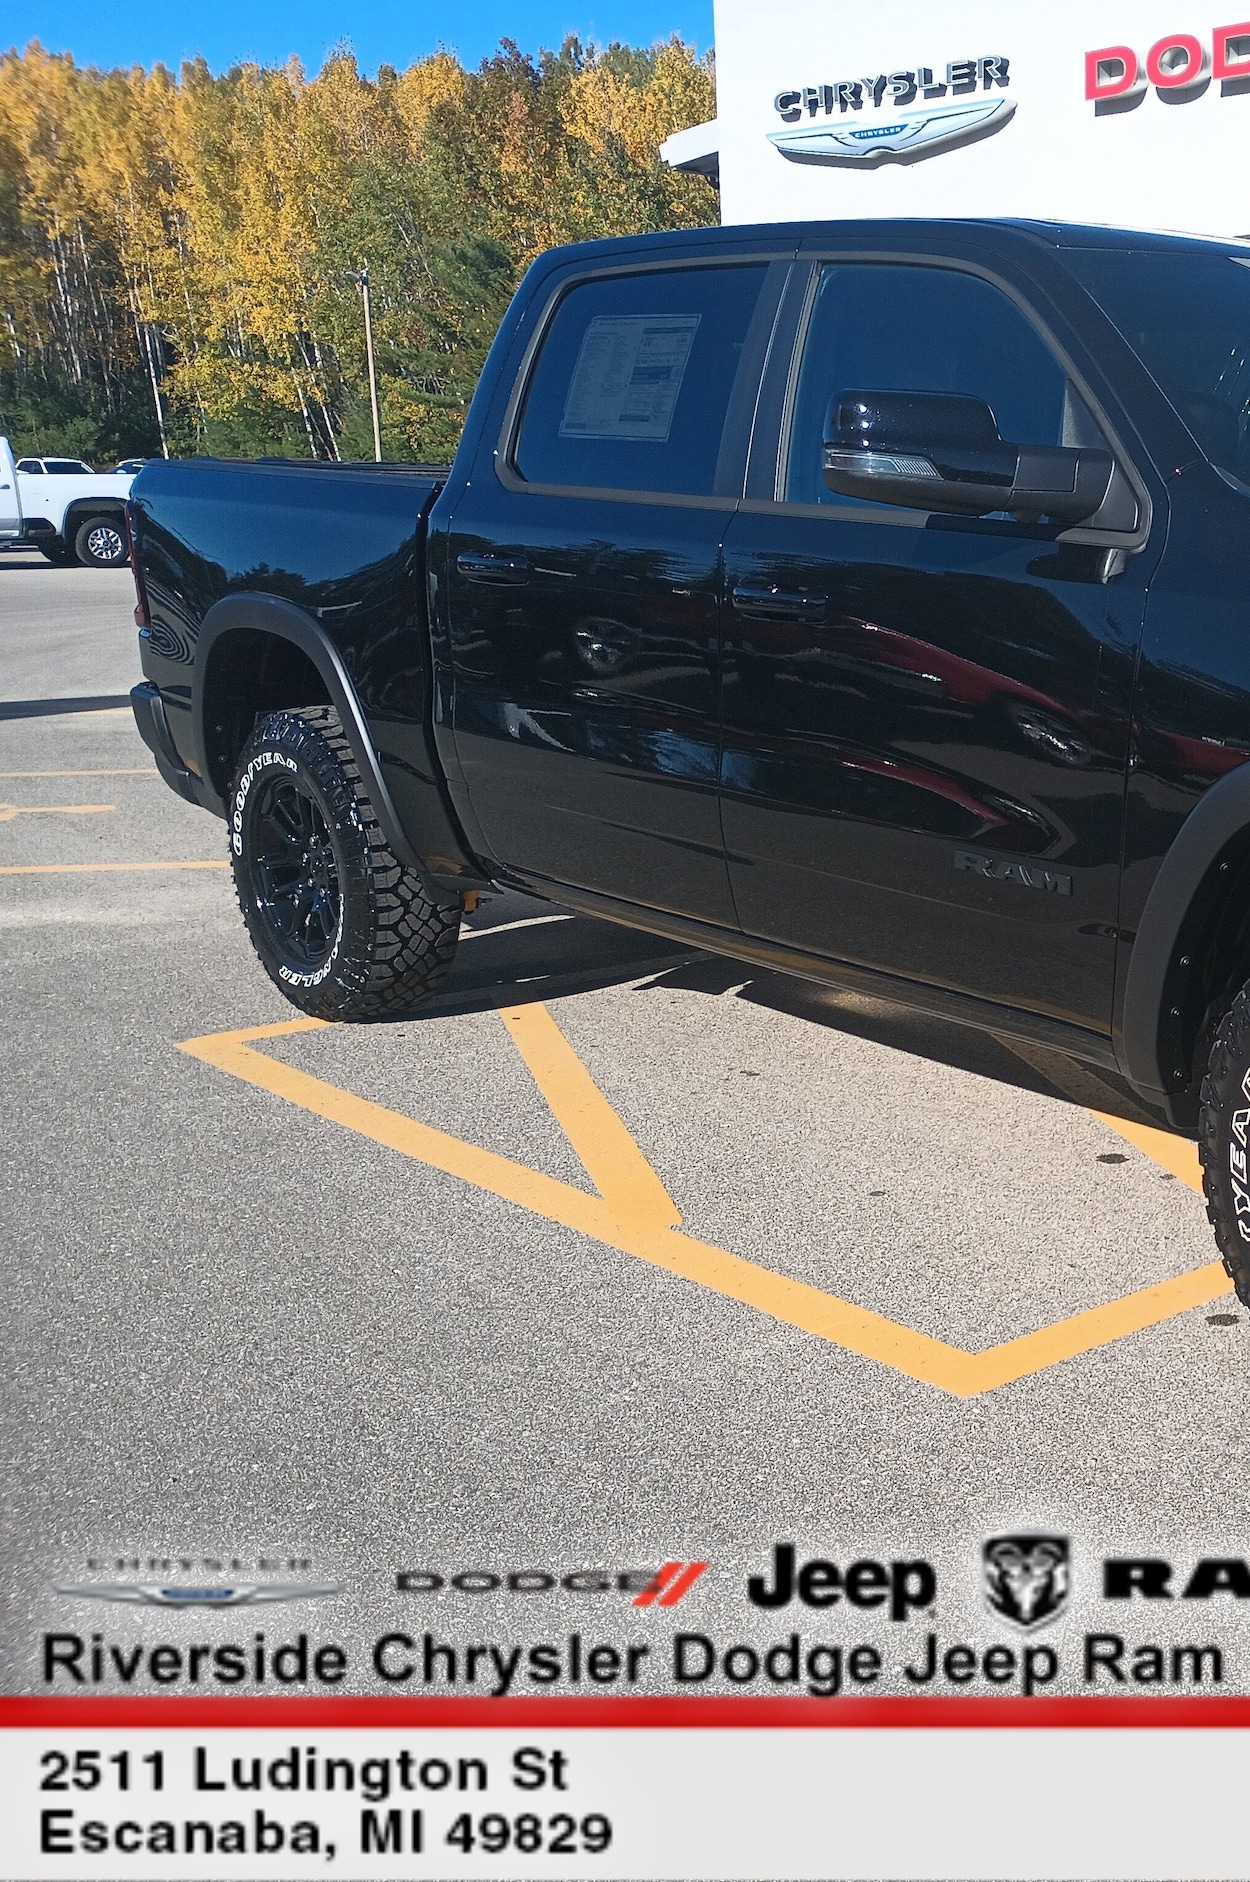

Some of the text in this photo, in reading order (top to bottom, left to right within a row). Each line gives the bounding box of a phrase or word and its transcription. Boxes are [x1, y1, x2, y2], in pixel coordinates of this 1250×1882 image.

[774, 55, 1010, 121] CHRYSLER
[854, 125, 903, 139] CHRYSLER
[232, 751, 299, 857] GOODYEAR
[953, 849, 1073, 896] RAM
